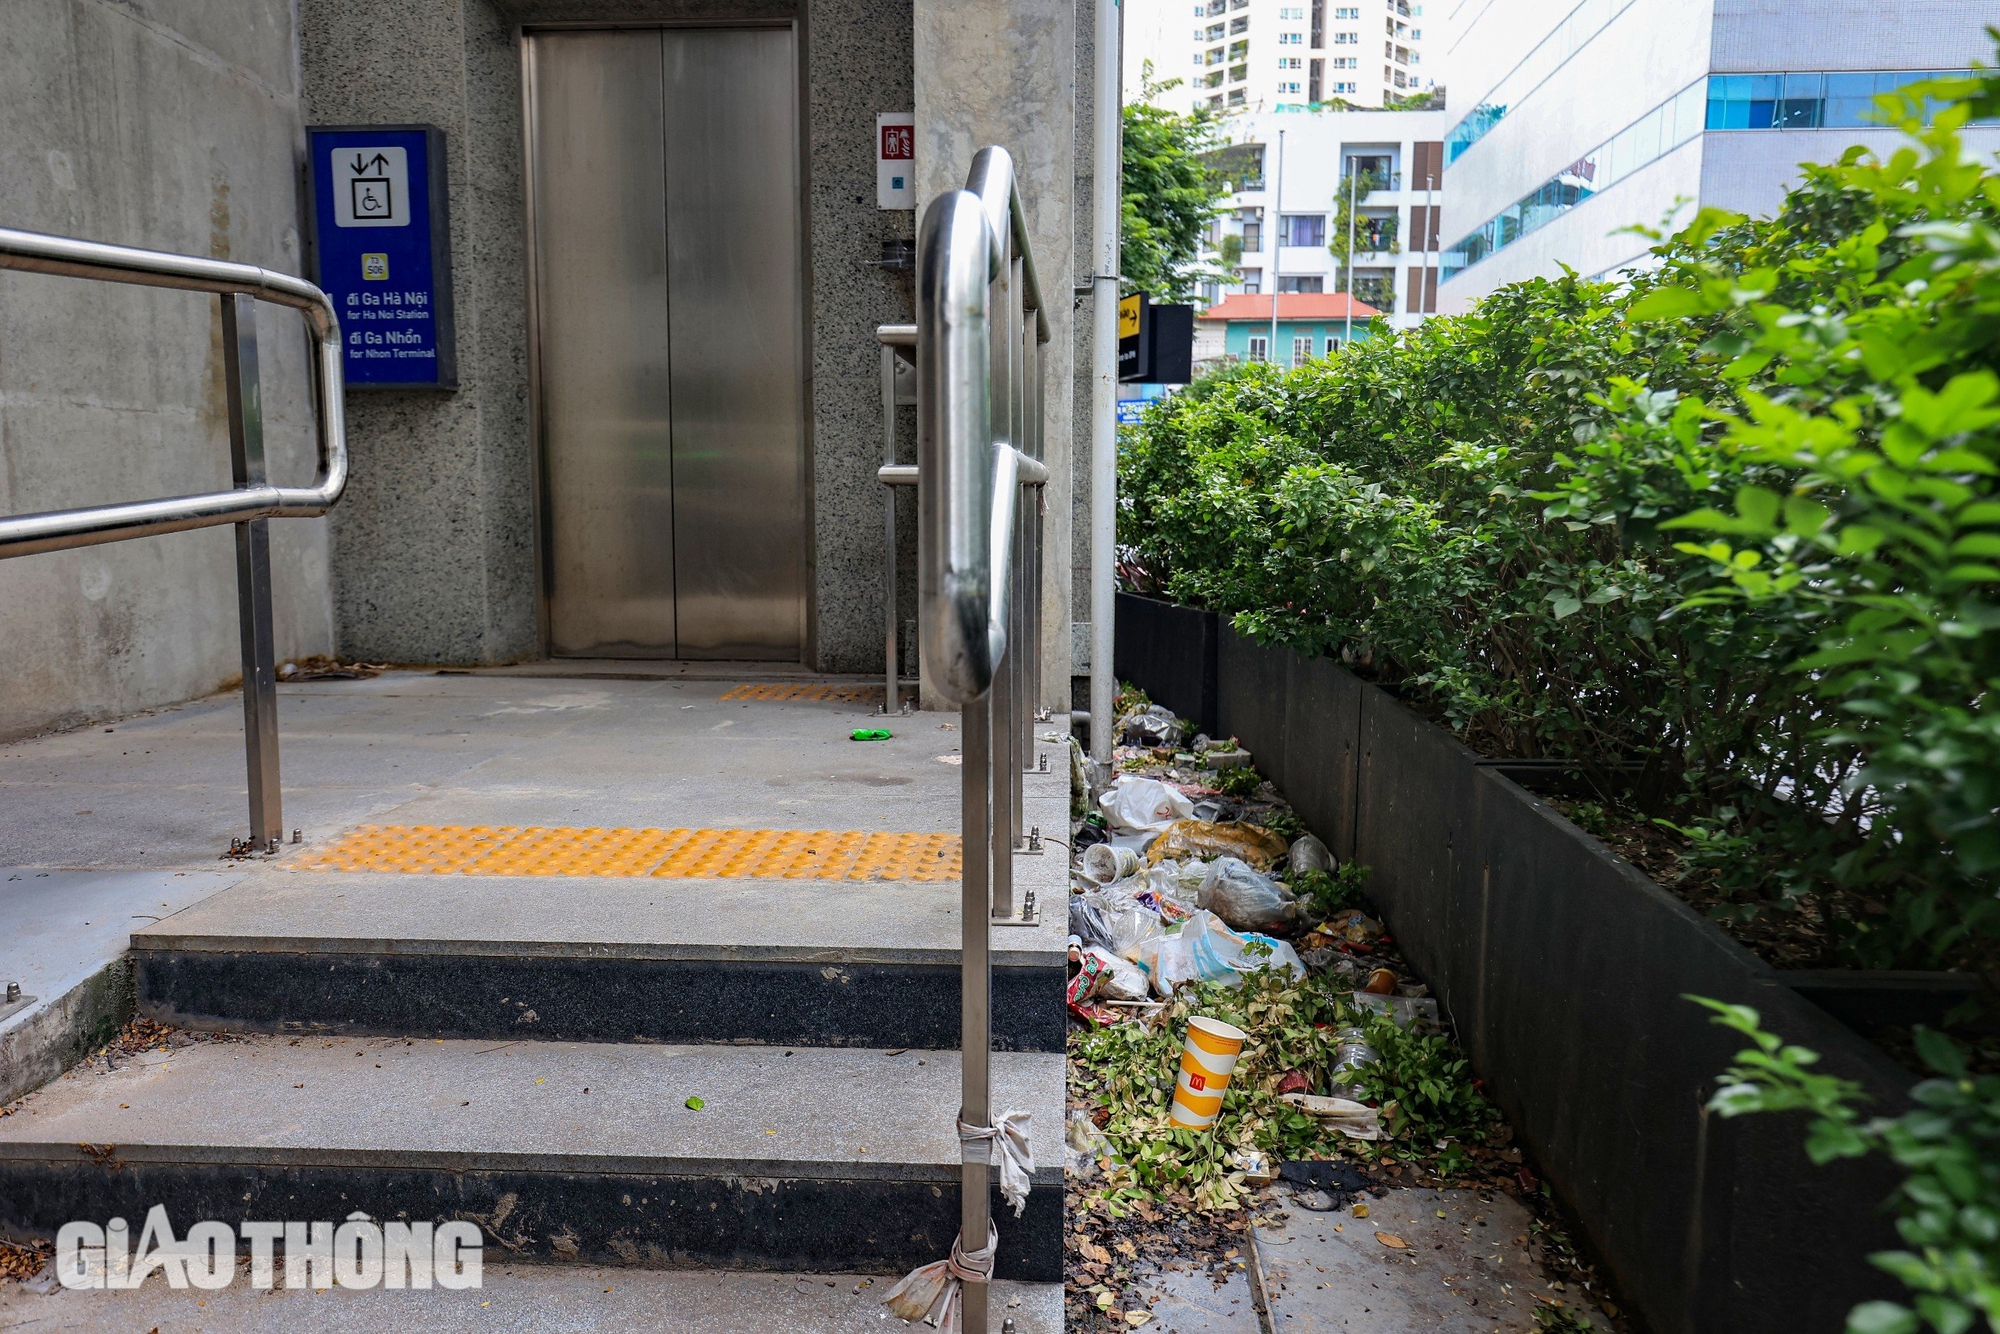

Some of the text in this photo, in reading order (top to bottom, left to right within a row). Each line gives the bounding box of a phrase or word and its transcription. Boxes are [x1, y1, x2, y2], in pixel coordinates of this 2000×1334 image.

[367, 265, 384, 274] S06
[347, 292, 359, 305] đi
[362, 292, 380, 305] Ga
[383, 291, 401, 305] Hà
[404, 291, 428, 308] Nội
[347, 309, 429, 319] for Ha Noi Station
[349, 328, 422, 344] đi Ga Nhổn
[350, 348, 436, 358] for Nhon Terminal
